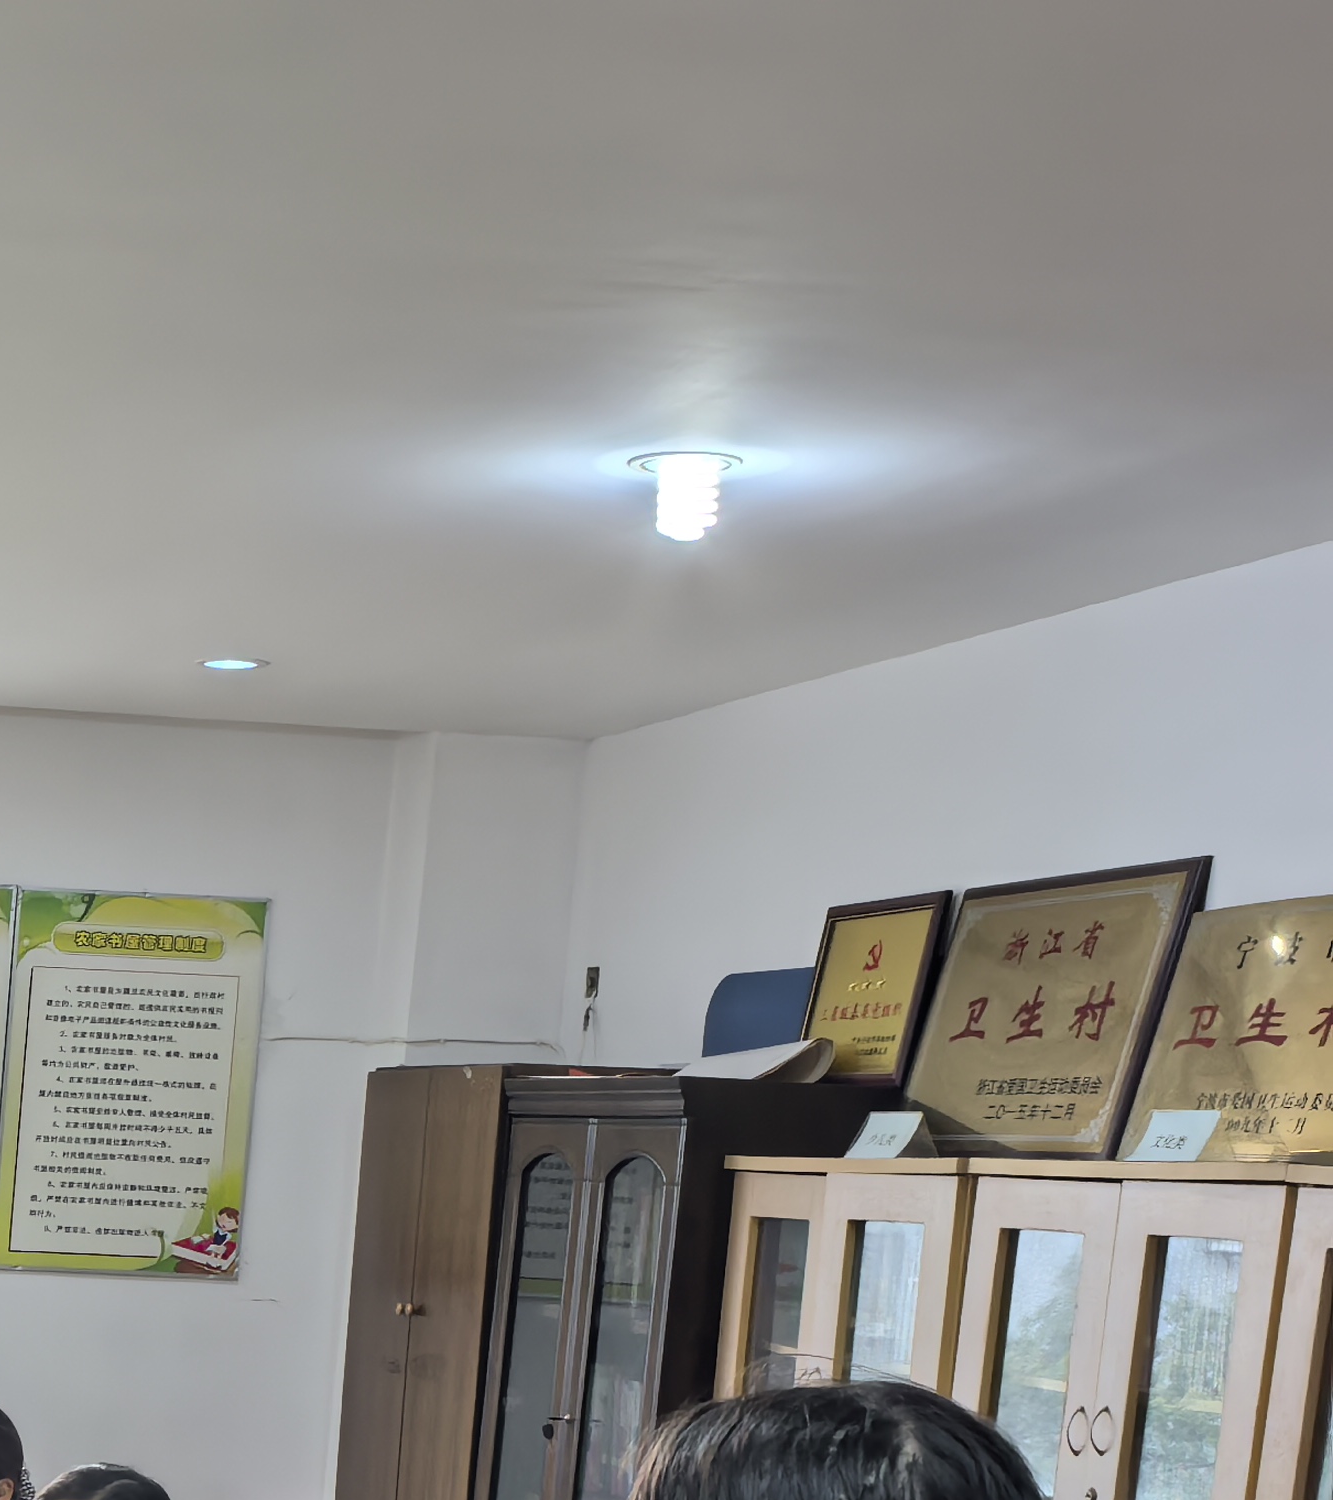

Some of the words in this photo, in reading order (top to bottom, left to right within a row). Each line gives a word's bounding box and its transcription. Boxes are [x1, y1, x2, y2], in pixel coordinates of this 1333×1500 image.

[74, 930, 207, 953] 农家书屋管理制度
[1002, 919, 1105, 965] 浙江省
[1236, 931, 1333, 970] 宁波
[949, 979, 1118, 1045] 卫生村
